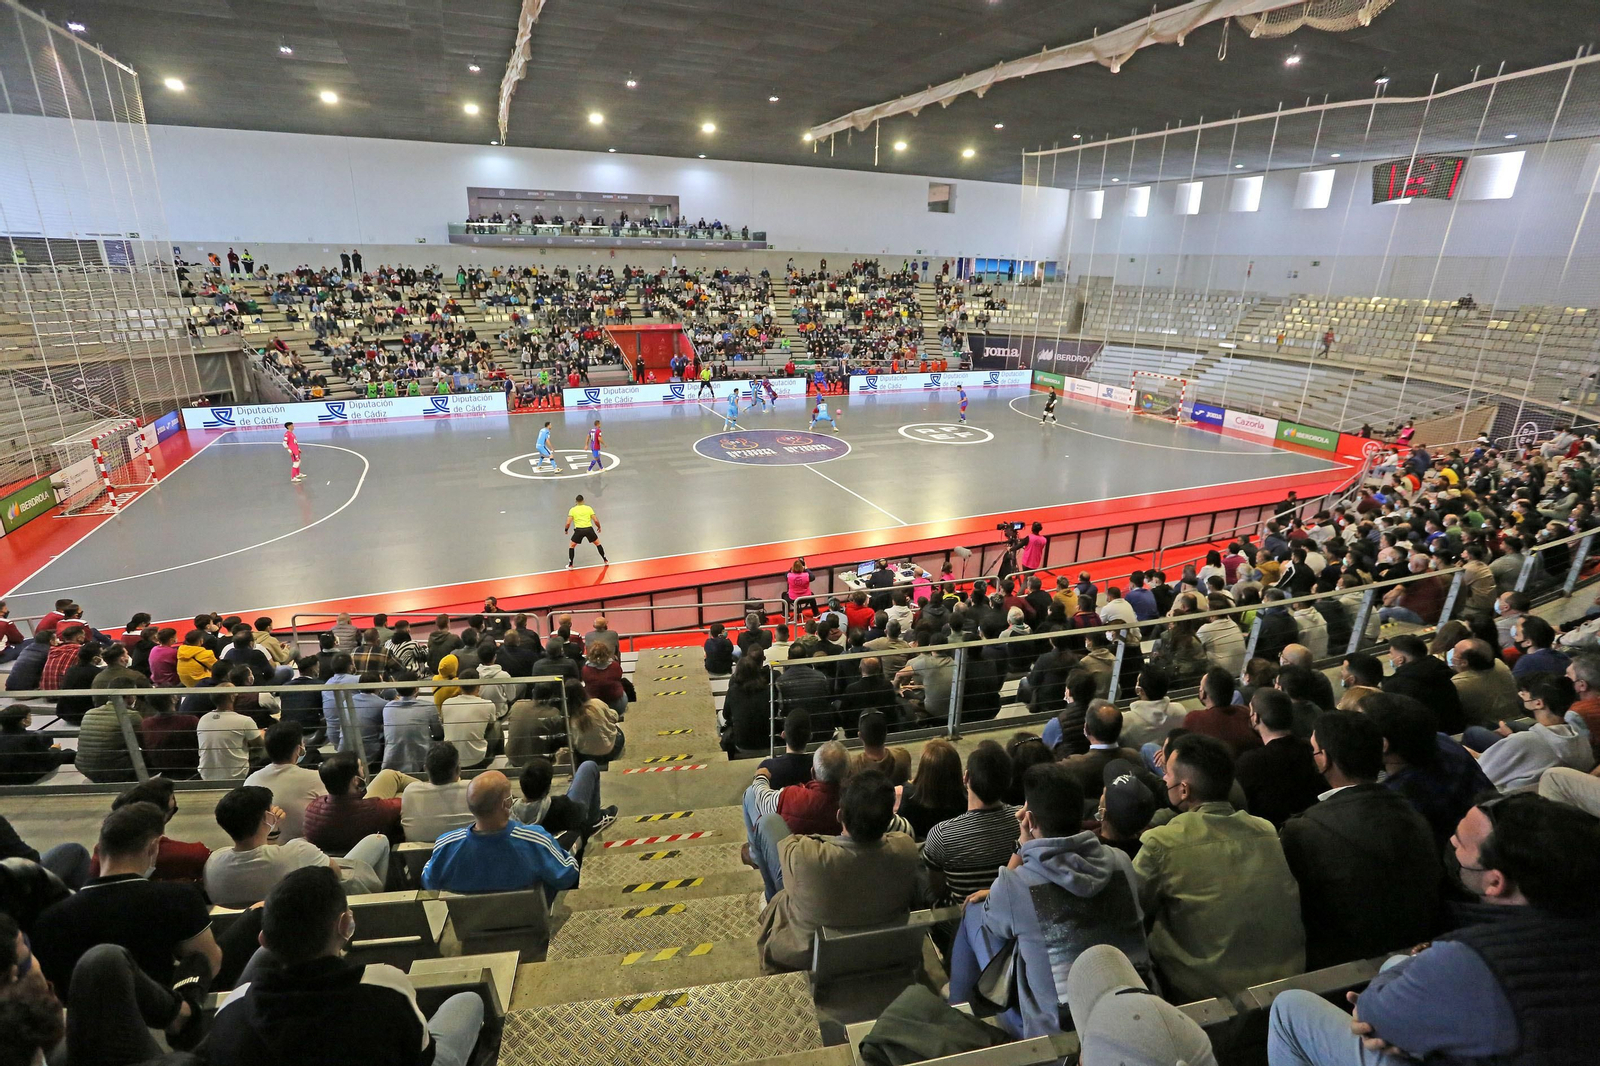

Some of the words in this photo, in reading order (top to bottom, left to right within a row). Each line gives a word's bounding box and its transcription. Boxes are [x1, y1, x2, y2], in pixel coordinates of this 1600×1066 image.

[1054, 353, 1093, 363] IBERDROL
[603, 386, 640, 395] Diputación
[451, 394, 493, 403] Diputación
[614, 396, 634, 404] Cádiz
[348, 400, 394, 409] Diputación
[453, 405, 463, 413] de
[465, 404, 487, 412] Cádiz
[236, 405, 286, 415] Diputación
[351, 411, 362, 419] de
[364, 410, 387, 418] Cádiz
[239, 418, 251, 426] de
[253, 416, 280, 425] Cádiz
[1235, 416, 1265, 430] Cazorla
[20, 490, 50, 513] IBERDROLA
